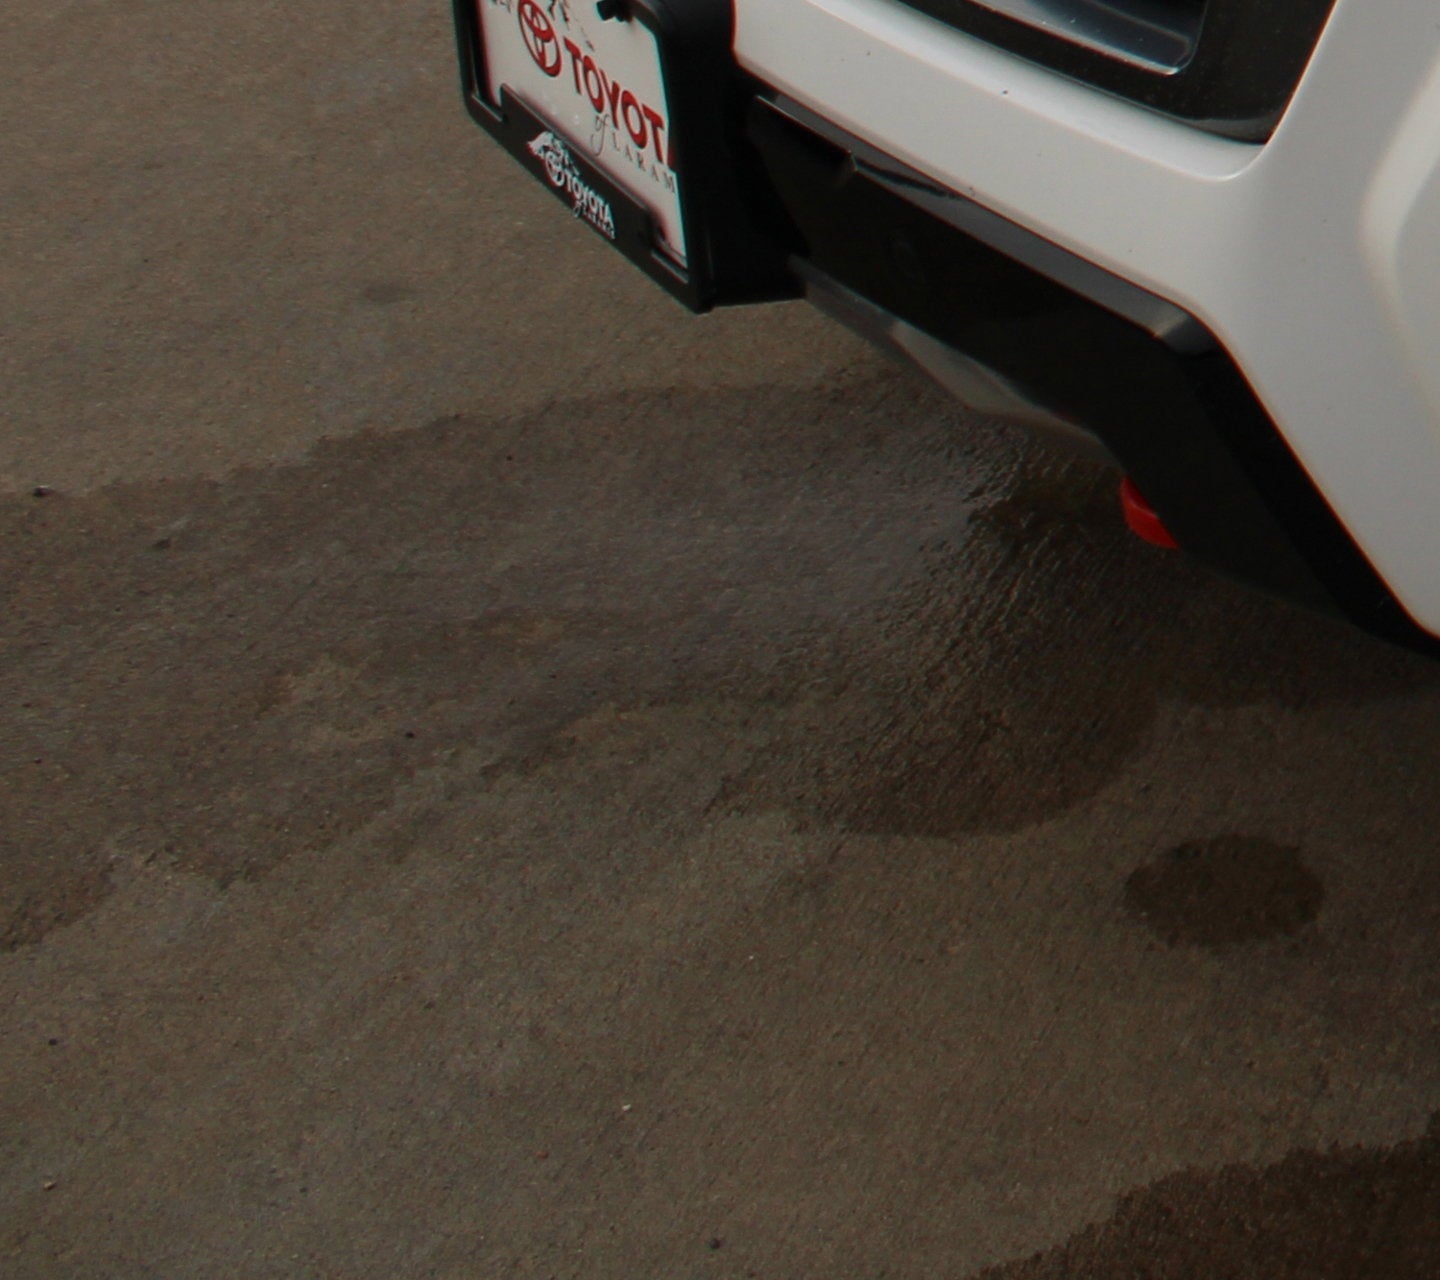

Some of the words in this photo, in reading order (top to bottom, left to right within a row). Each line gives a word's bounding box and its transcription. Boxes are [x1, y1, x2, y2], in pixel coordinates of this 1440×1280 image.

[563, 36, 667, 164] TOYOT
[612, 131, 675, 194] LARAM
[564, 168, 615, 230] TOYOTA
